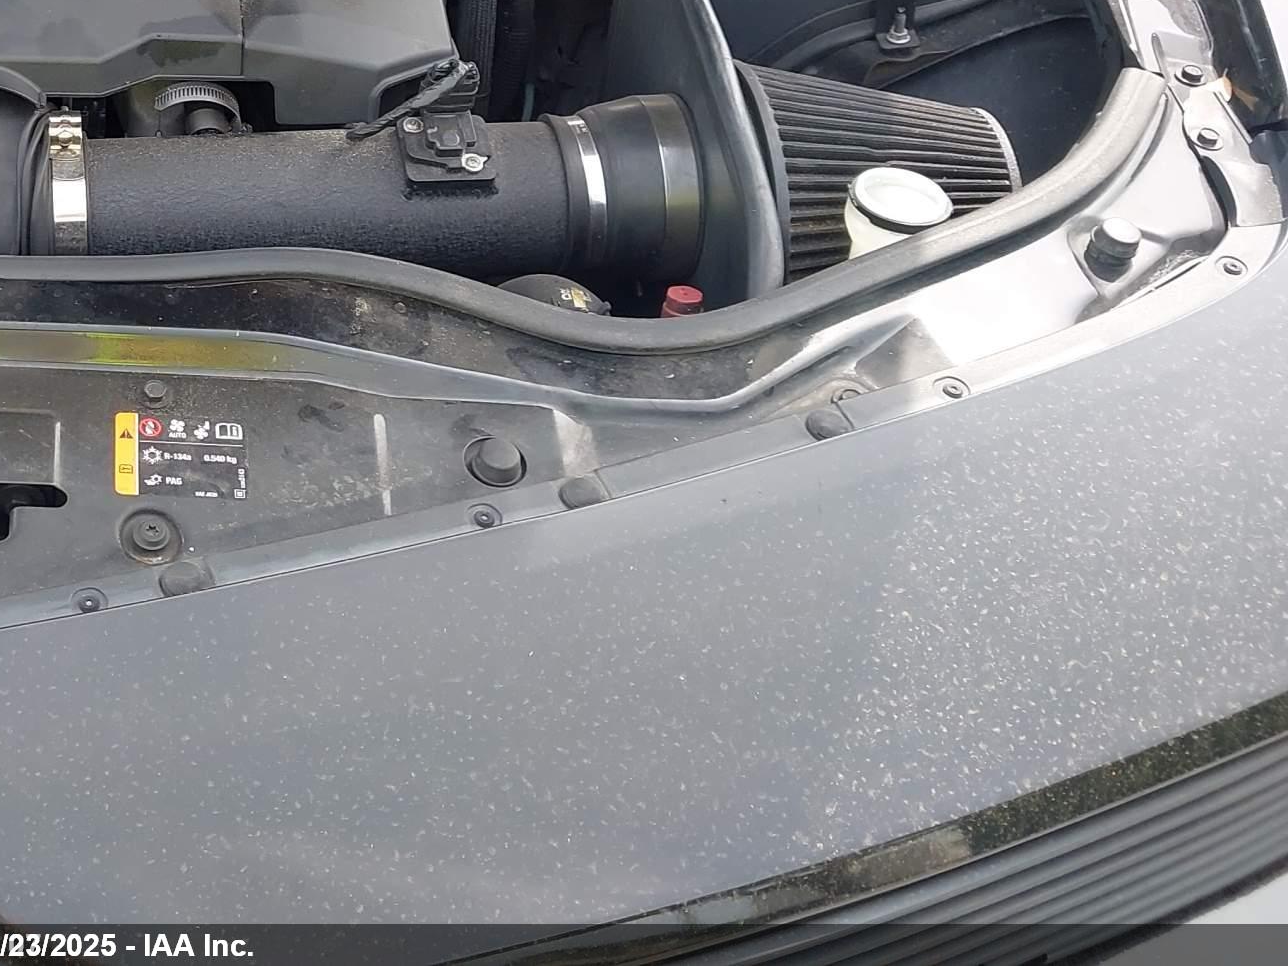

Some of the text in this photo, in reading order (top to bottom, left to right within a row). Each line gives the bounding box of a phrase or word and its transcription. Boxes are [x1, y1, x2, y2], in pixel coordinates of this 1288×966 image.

[164, 452, 192, 461] R-134a
[226, 455, 237, 464] kg
[165, 477, 183, 485] PAG
